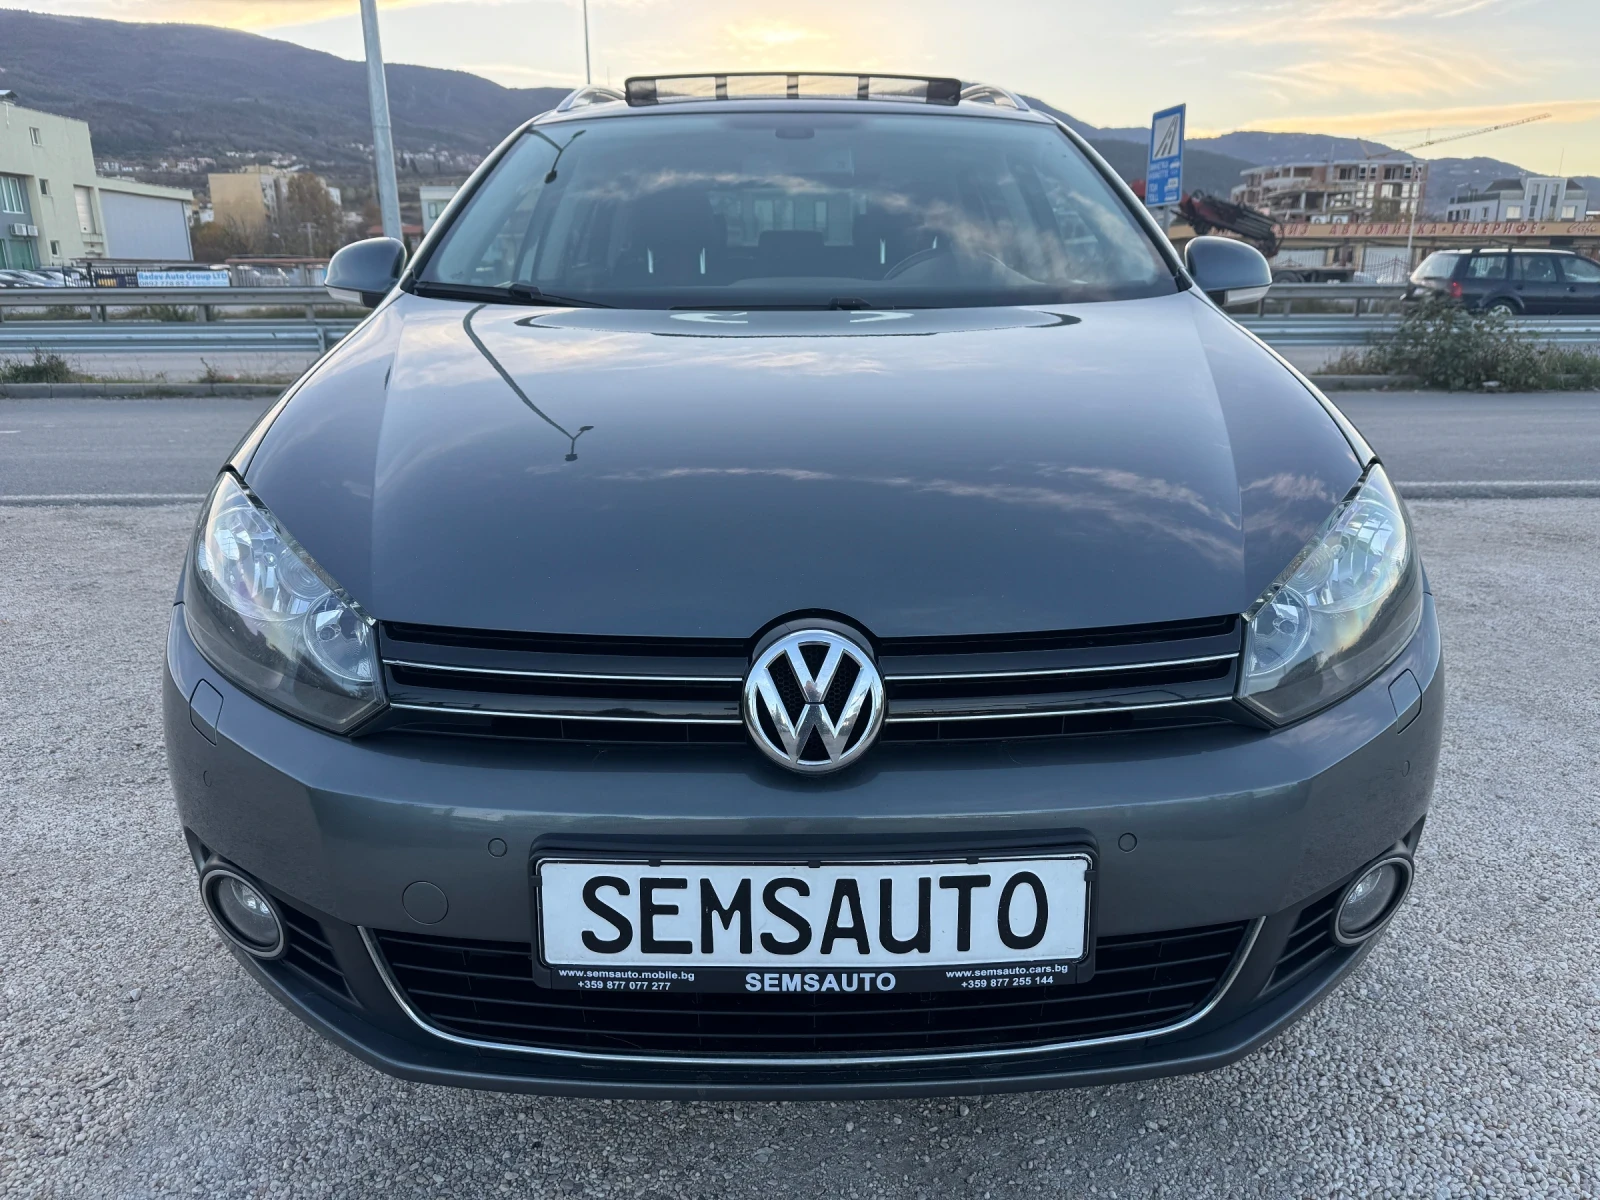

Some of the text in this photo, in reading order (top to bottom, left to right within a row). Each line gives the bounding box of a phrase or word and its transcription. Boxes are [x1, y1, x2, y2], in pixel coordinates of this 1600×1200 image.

[1451, 222, 1538, 234] ТЕНЕРИФЕ
[139, 272, 228, 282] Radev Auto Group LTD
[749, 635, 875, 765] VW
[580, 870, 1049, 956] SEMSAUTO
[558, 969, 695, 982] www.semsauto.mobile.bg
[945, 963, 1069, 978] www.semsauto.cars.bg
[577, 980, 672, 990] +359 877 077 277
[744, 973, 897, 993] SEMSAUTO
[960, 975, 1054, 989] +359 877 255 144
